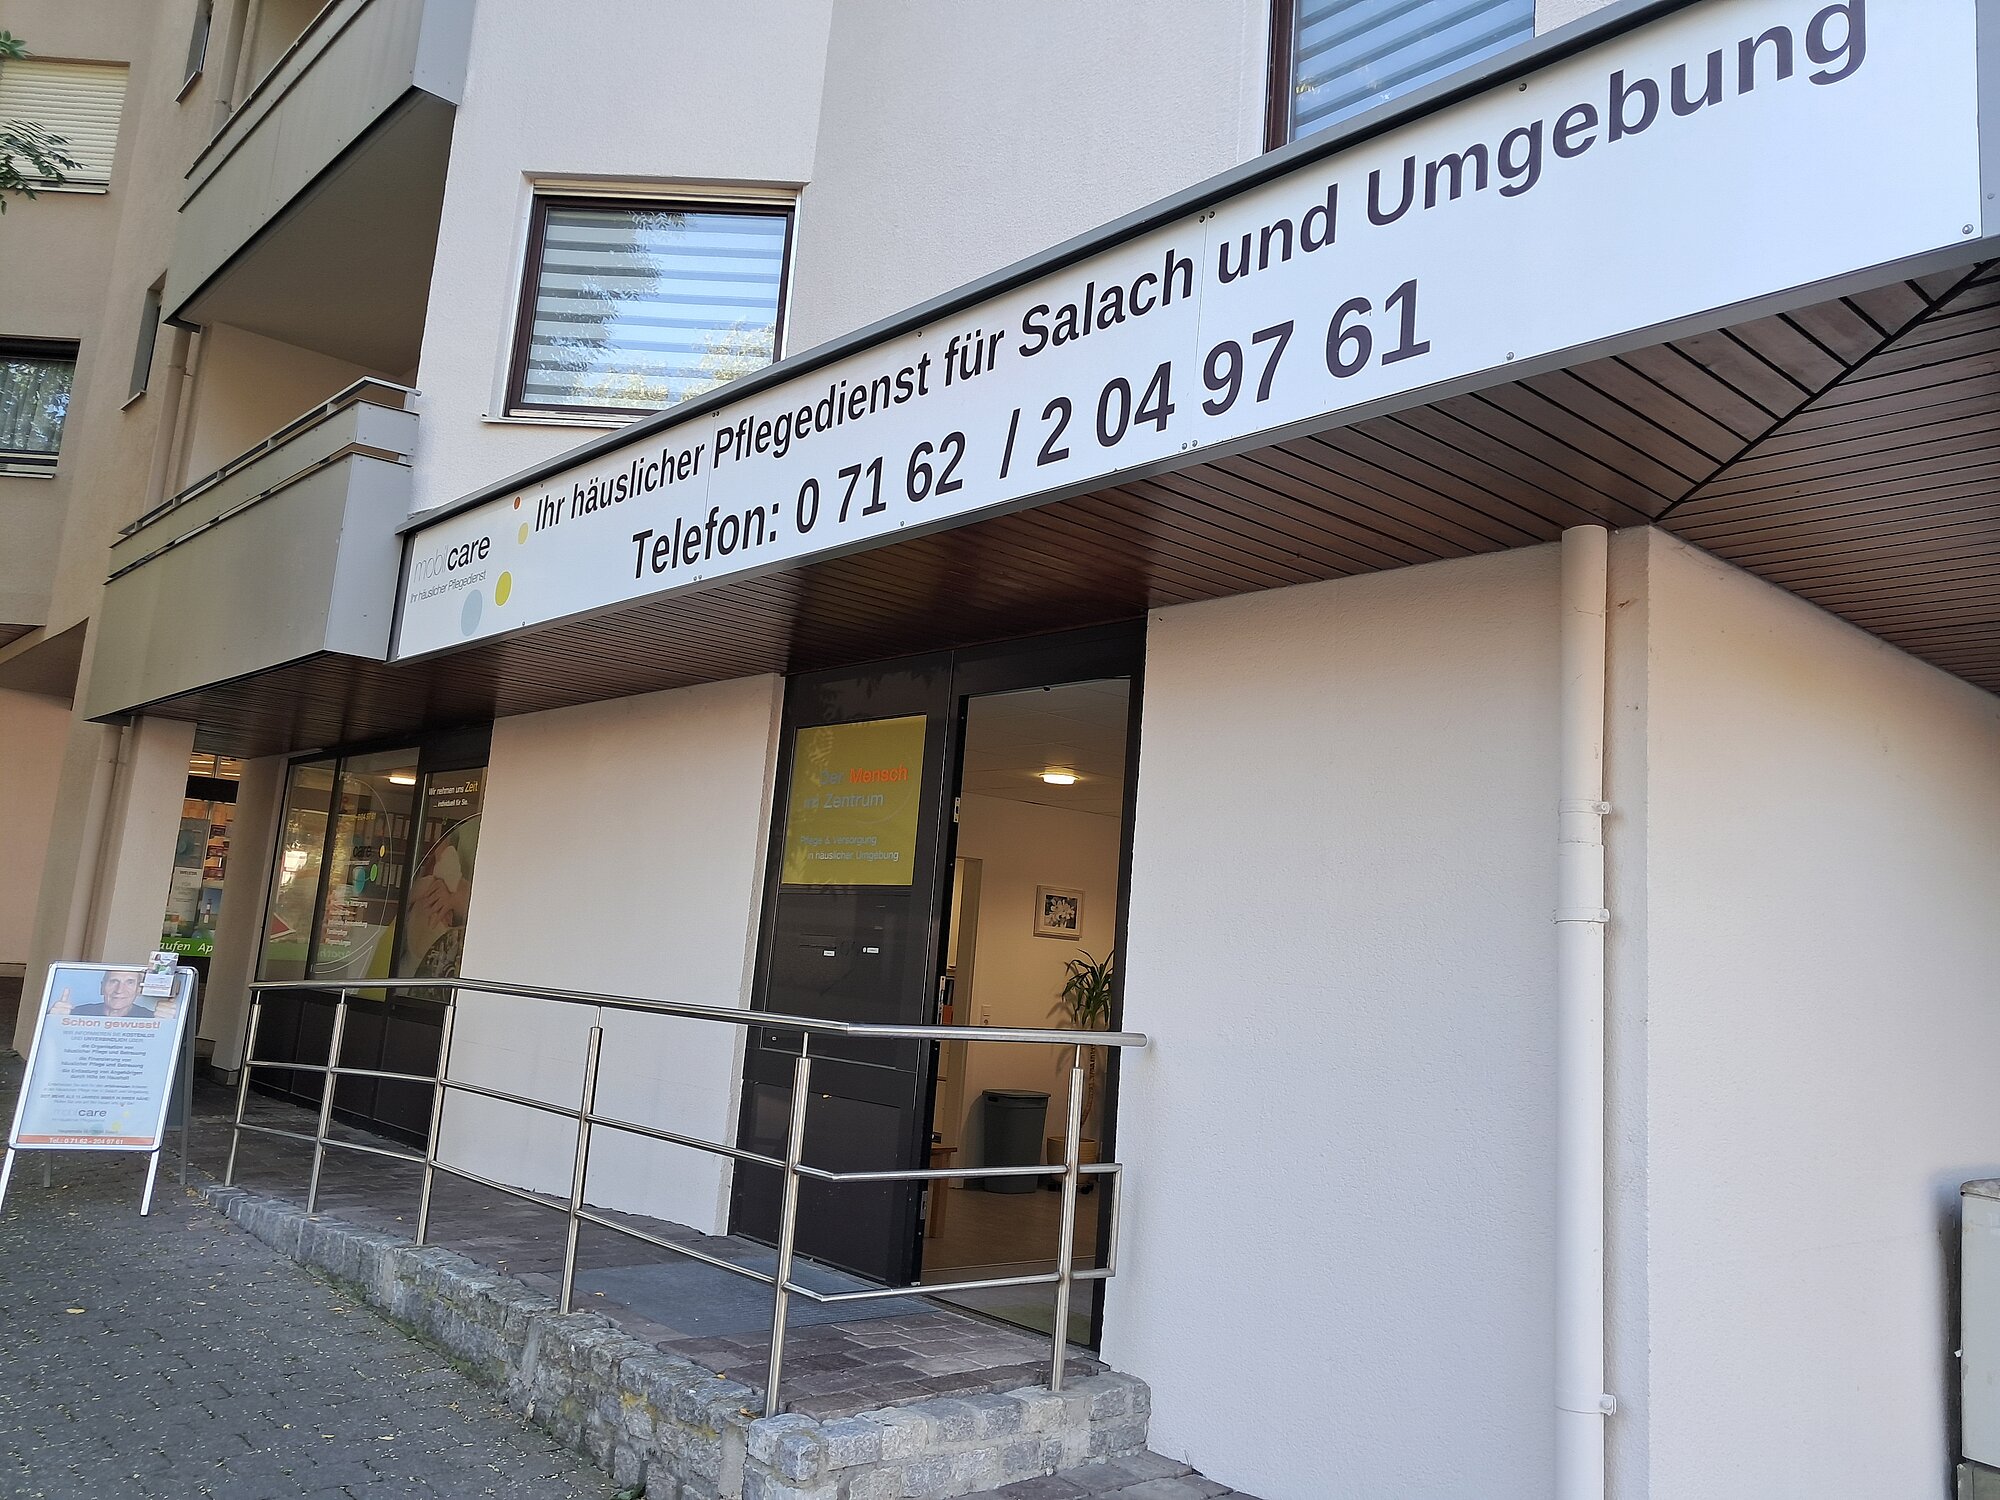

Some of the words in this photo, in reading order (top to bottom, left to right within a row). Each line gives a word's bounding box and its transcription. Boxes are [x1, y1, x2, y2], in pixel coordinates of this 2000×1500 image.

[535, 493, 566, 533] Ihr
[570, 443, 706, 520] häuslicher
[713, 352, 932, 470] Pflegedienst
[944, 327, 1005, 387] für
[1018, 248, 1195, 358] Salach
[1218, 182, 1340, 284] und
[1367, 0, 1868, 227] Umgebung
[631, 502, 781, 580] Telefon:
[796, 477, 820, 534] 0
[837, 455, 888, 524] 71
[906, 431, 966, 503] 62
[999, 407, 1021, 480] /
[1036, 396, 1072, 467] 2
[1096, 360, 1176, 448] 04
[1201, 319, 1295, 417] 97
[1325, 278, 1432, 379] 61
[414, 536, 491, 583] mobilcare
[410, 592, 419, 603] Ihr
[419, 582, 448, 600] häuslicher
[447, 569, 486, 591] Pflegedienst
[820, 767, 844, 785] Der
[849, 762, 908, 784] Mensch
[428, 787, 436, 796] Wir
[437, 786, 455, 795] nehmen
[465, 780, 478, 793] Zeit
[823, 792, 884, 809] Zentrum
[833, 835, 877, 847] Versorgung
[816, 850, 852, 861] häuslicher
[856, 850, 899, 862] Umgebung
[61, 1017, 101, 1027] Schon
